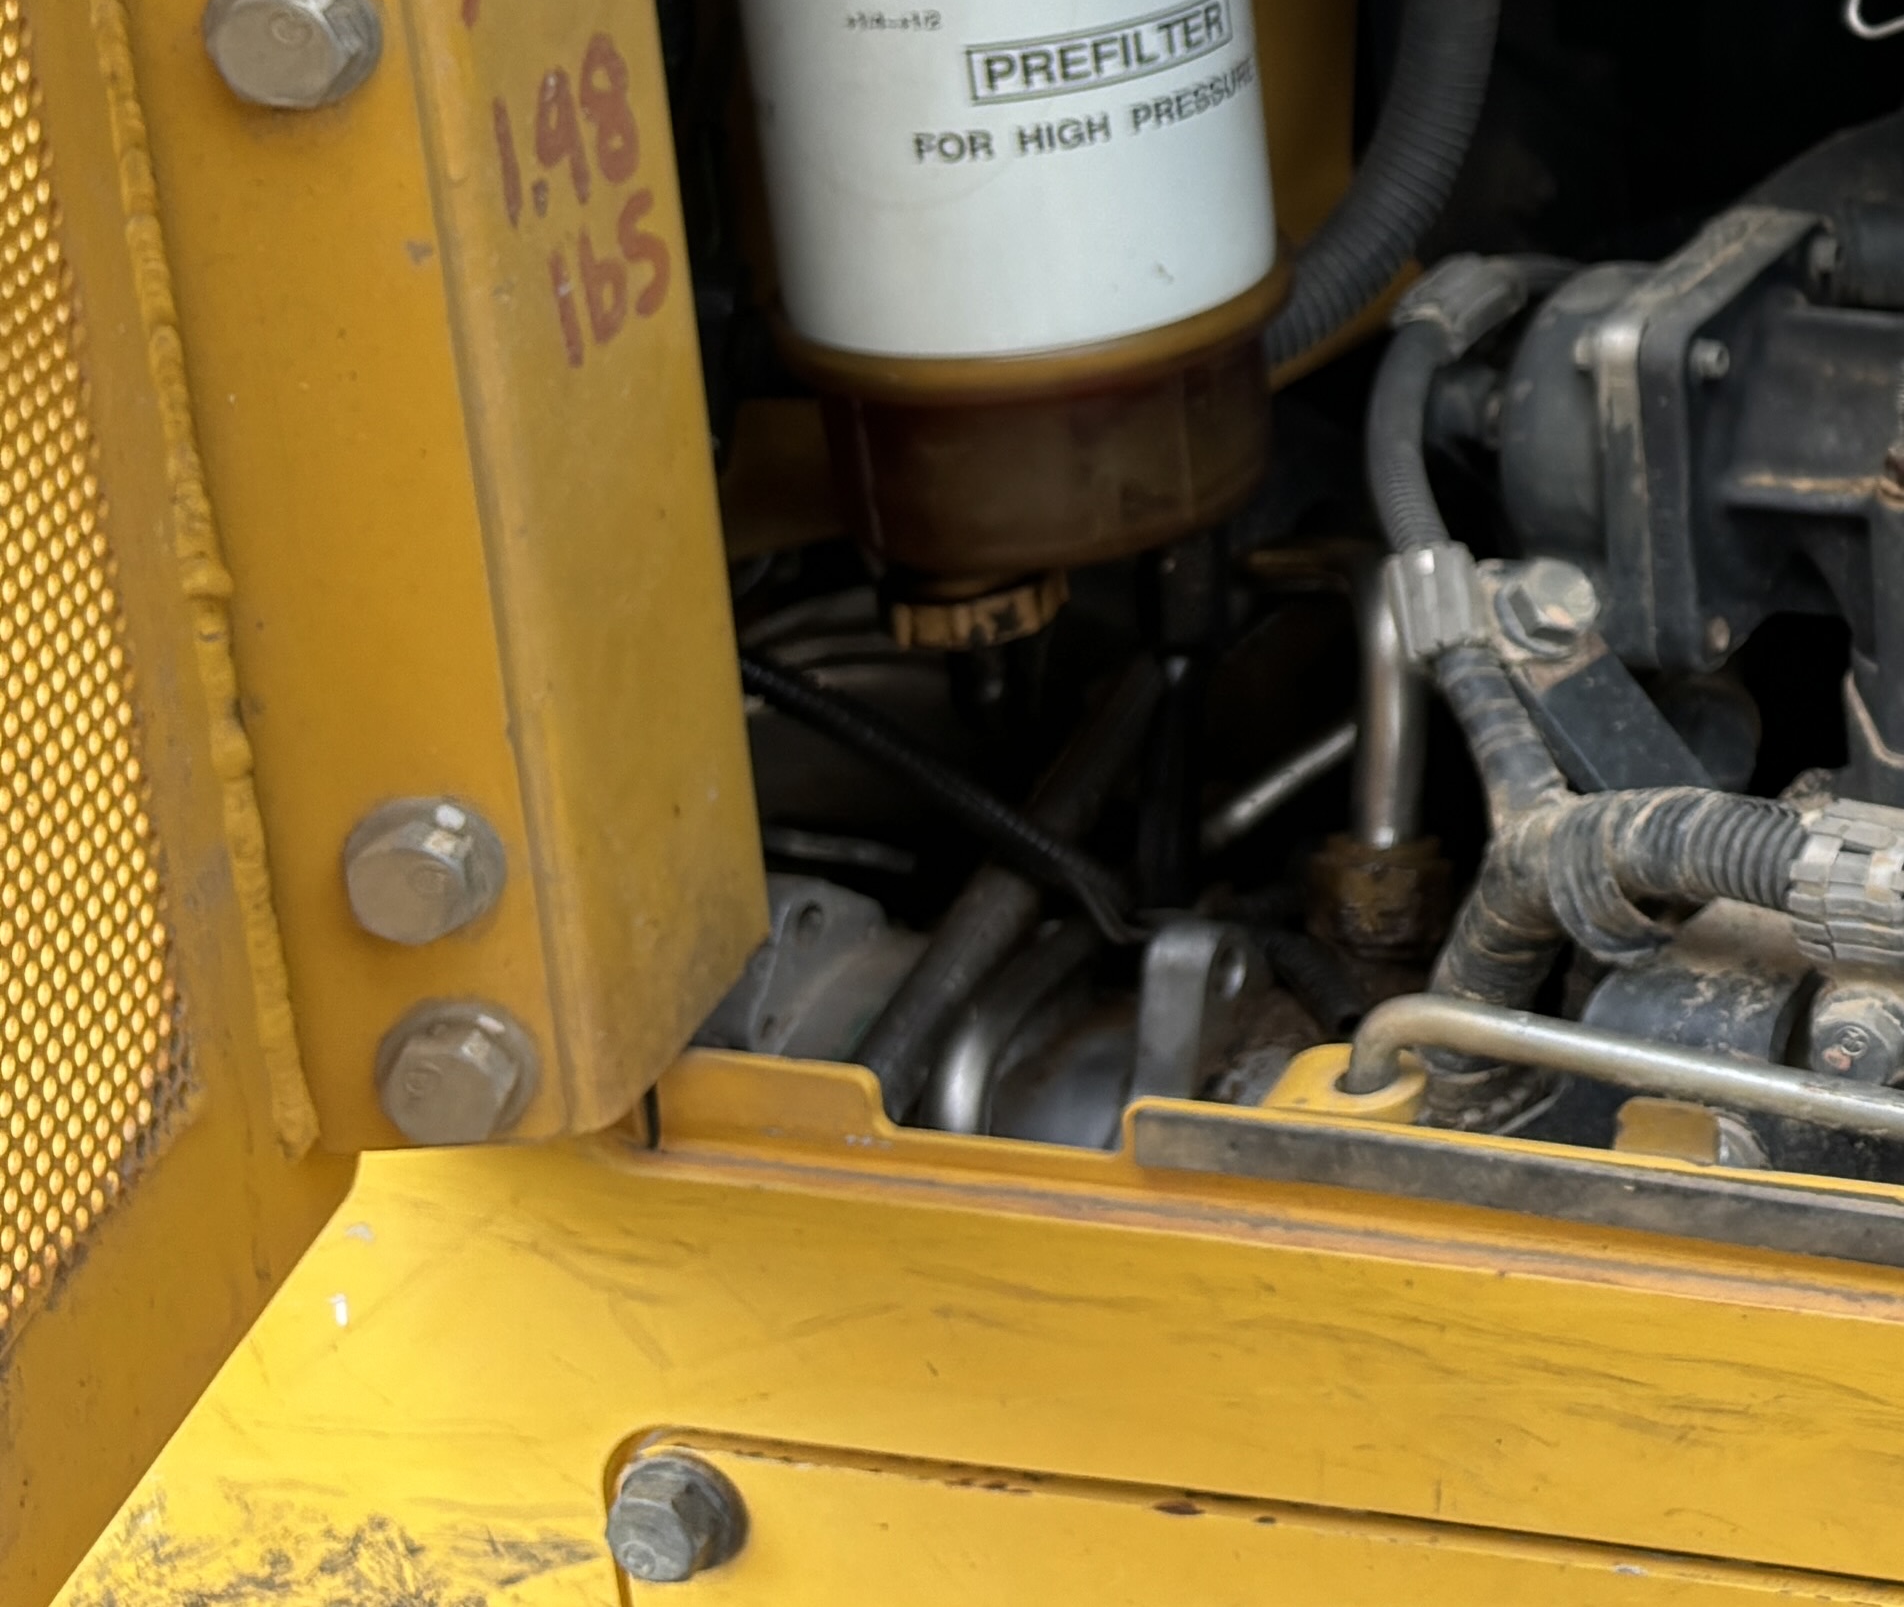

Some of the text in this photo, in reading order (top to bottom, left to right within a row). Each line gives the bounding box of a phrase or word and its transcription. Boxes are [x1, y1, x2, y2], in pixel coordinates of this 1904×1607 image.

[984, 0, 1225, 92] PREFILTER
[492, 32, 639, 230] 1.98
[913, 129, 995, 165] FOR
[1017, 111, 1112, 156] HIGH
